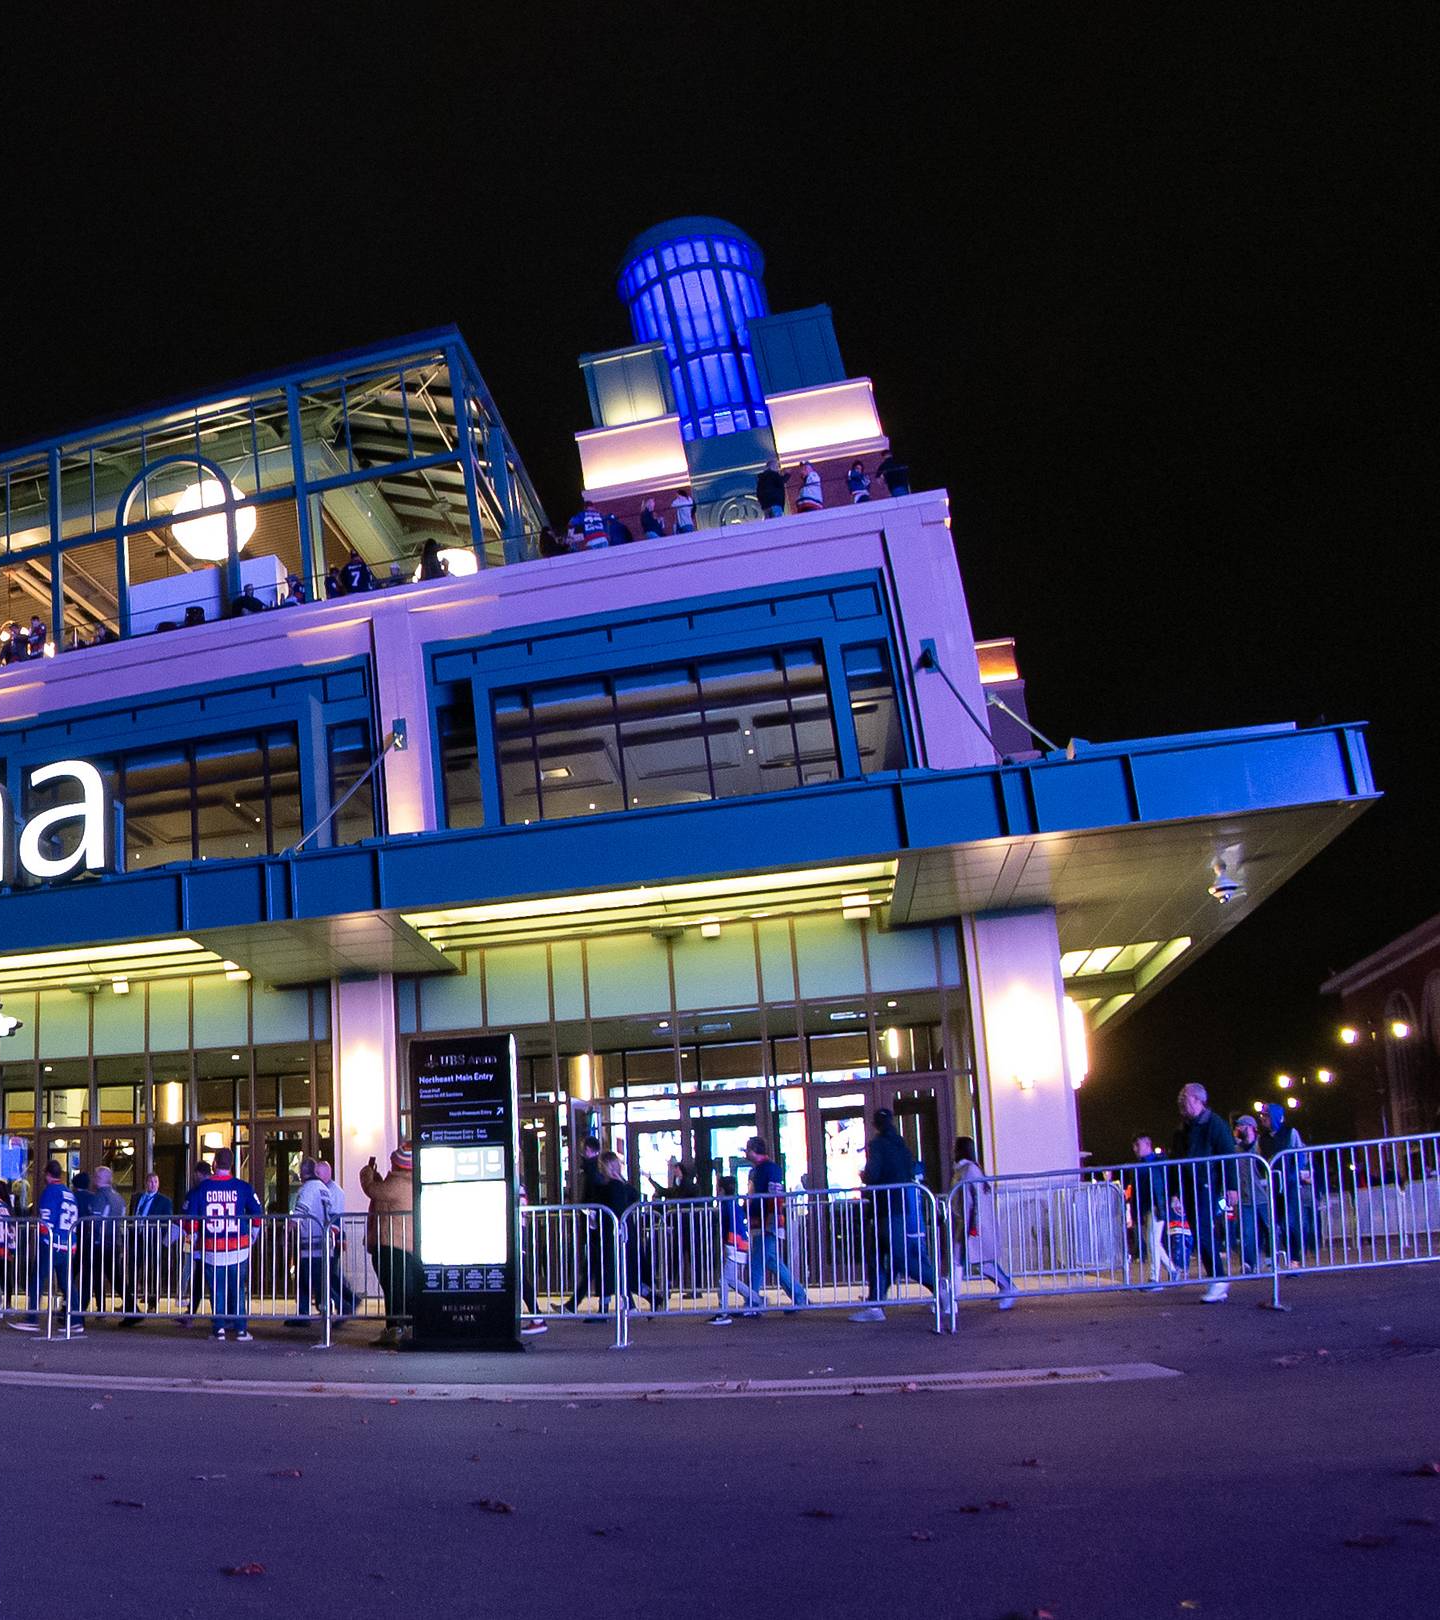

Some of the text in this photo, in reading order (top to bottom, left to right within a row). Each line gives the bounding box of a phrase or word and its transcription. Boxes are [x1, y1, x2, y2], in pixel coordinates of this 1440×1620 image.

[351, 571, 360, 587] 7
[440, 1054, 465, 1067] UBS
[419, 1072, 494, 1084] Northeast Main Entry
[206, 1190, 238, 1203] GORING
[206, 1203, 238, 1233] 91
